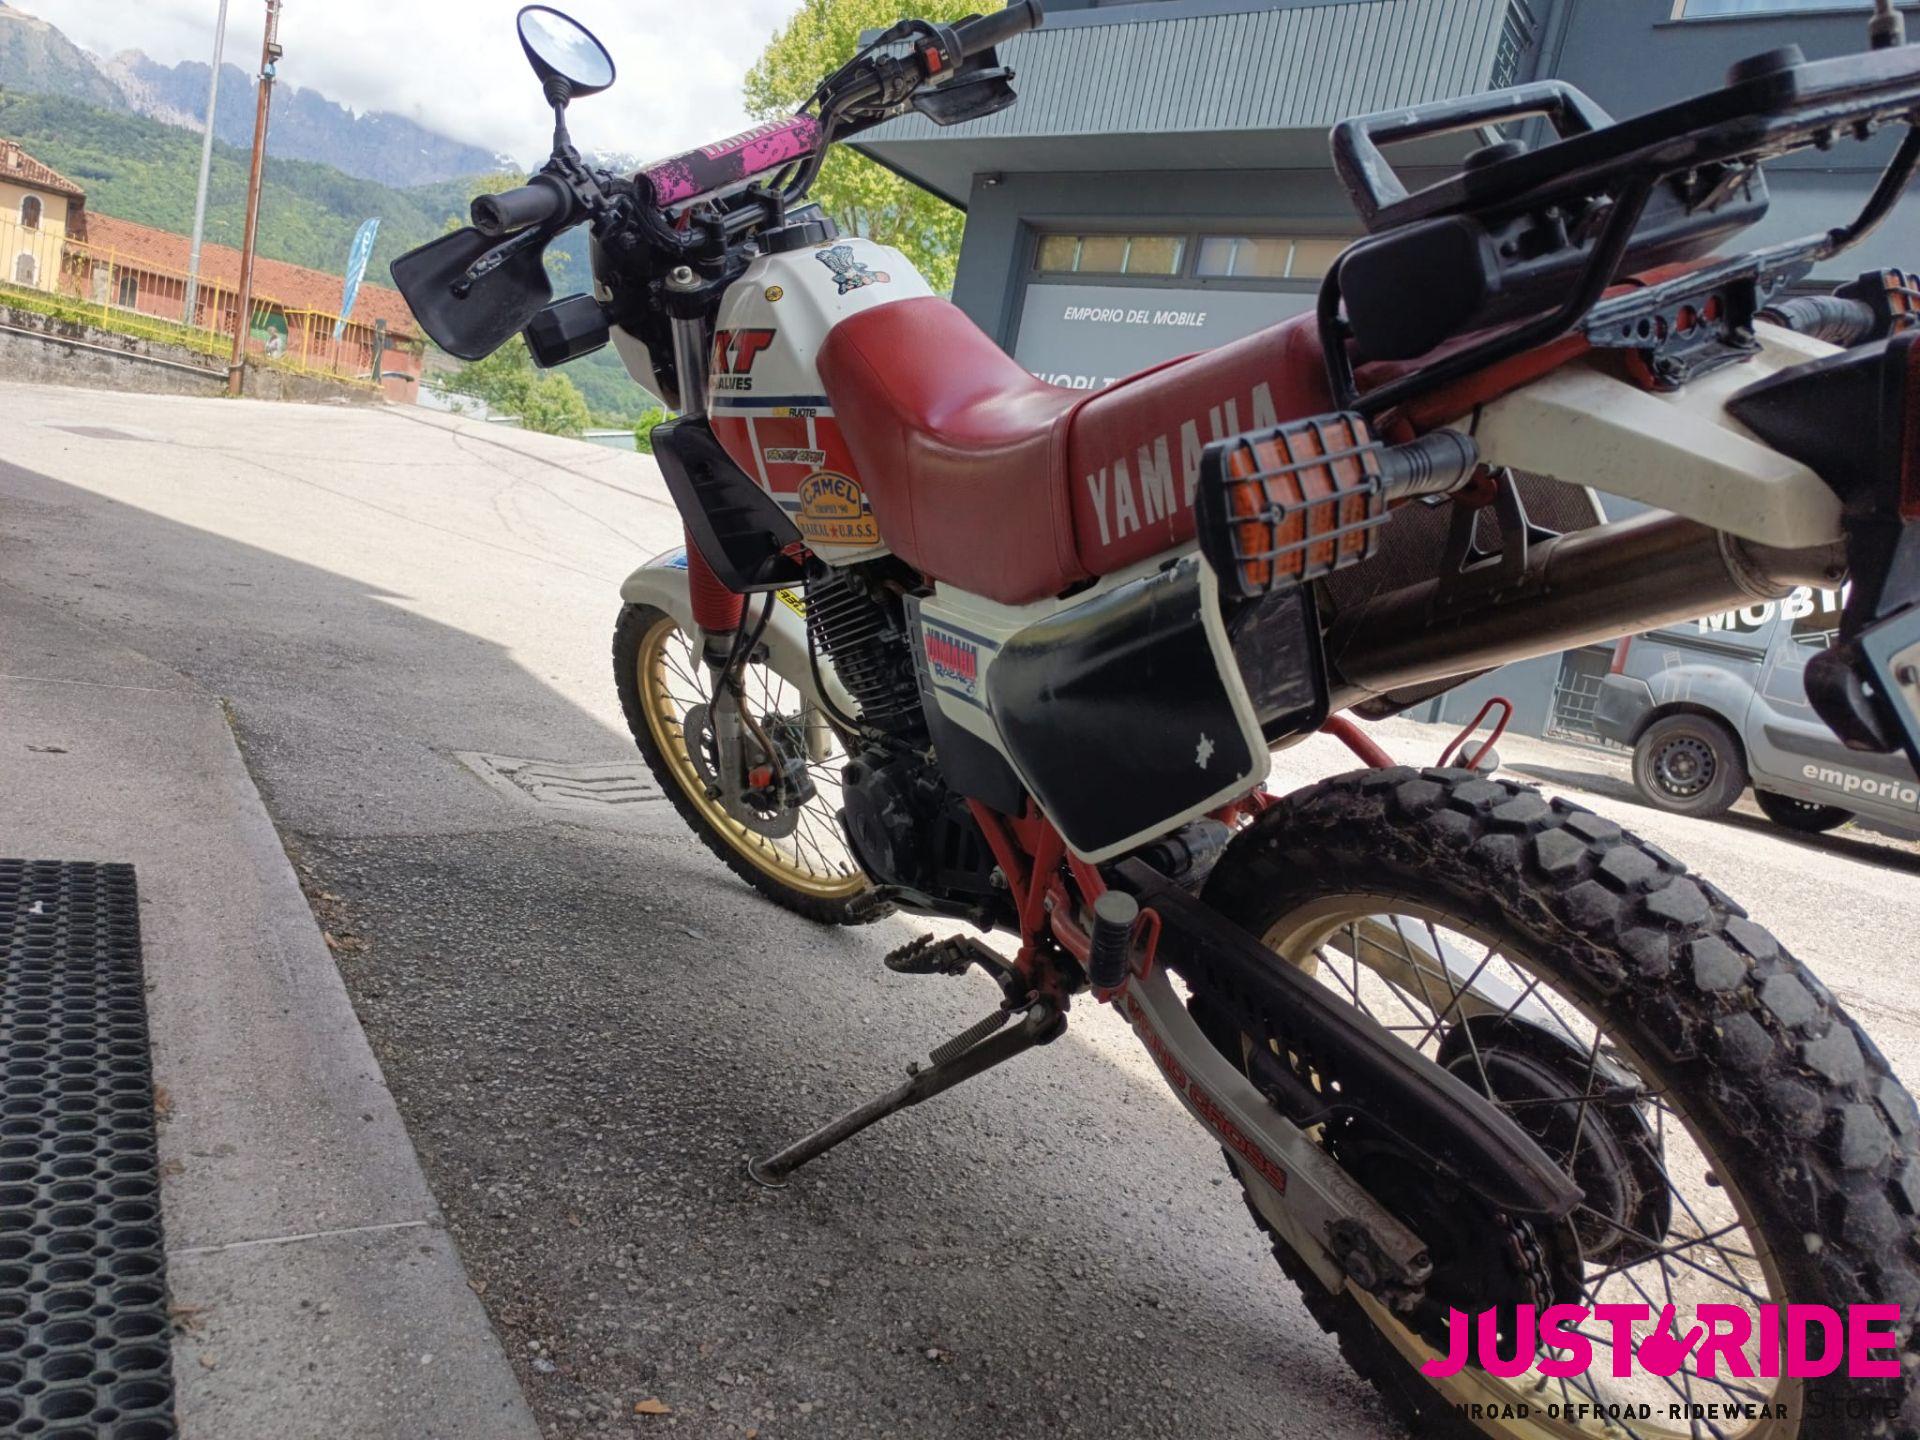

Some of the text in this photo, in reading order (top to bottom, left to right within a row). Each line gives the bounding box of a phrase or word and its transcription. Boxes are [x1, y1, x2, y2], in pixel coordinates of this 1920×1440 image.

[1064, 306, 1207, 327] EMPORIO DEL MOBILE
[717, 376, 753, 391] ALVES
[804, 479, 858, 505] CAMEL
[1698, 580, 1852, 635] MOBI
[1802, 764, 1917, 803] emporio
